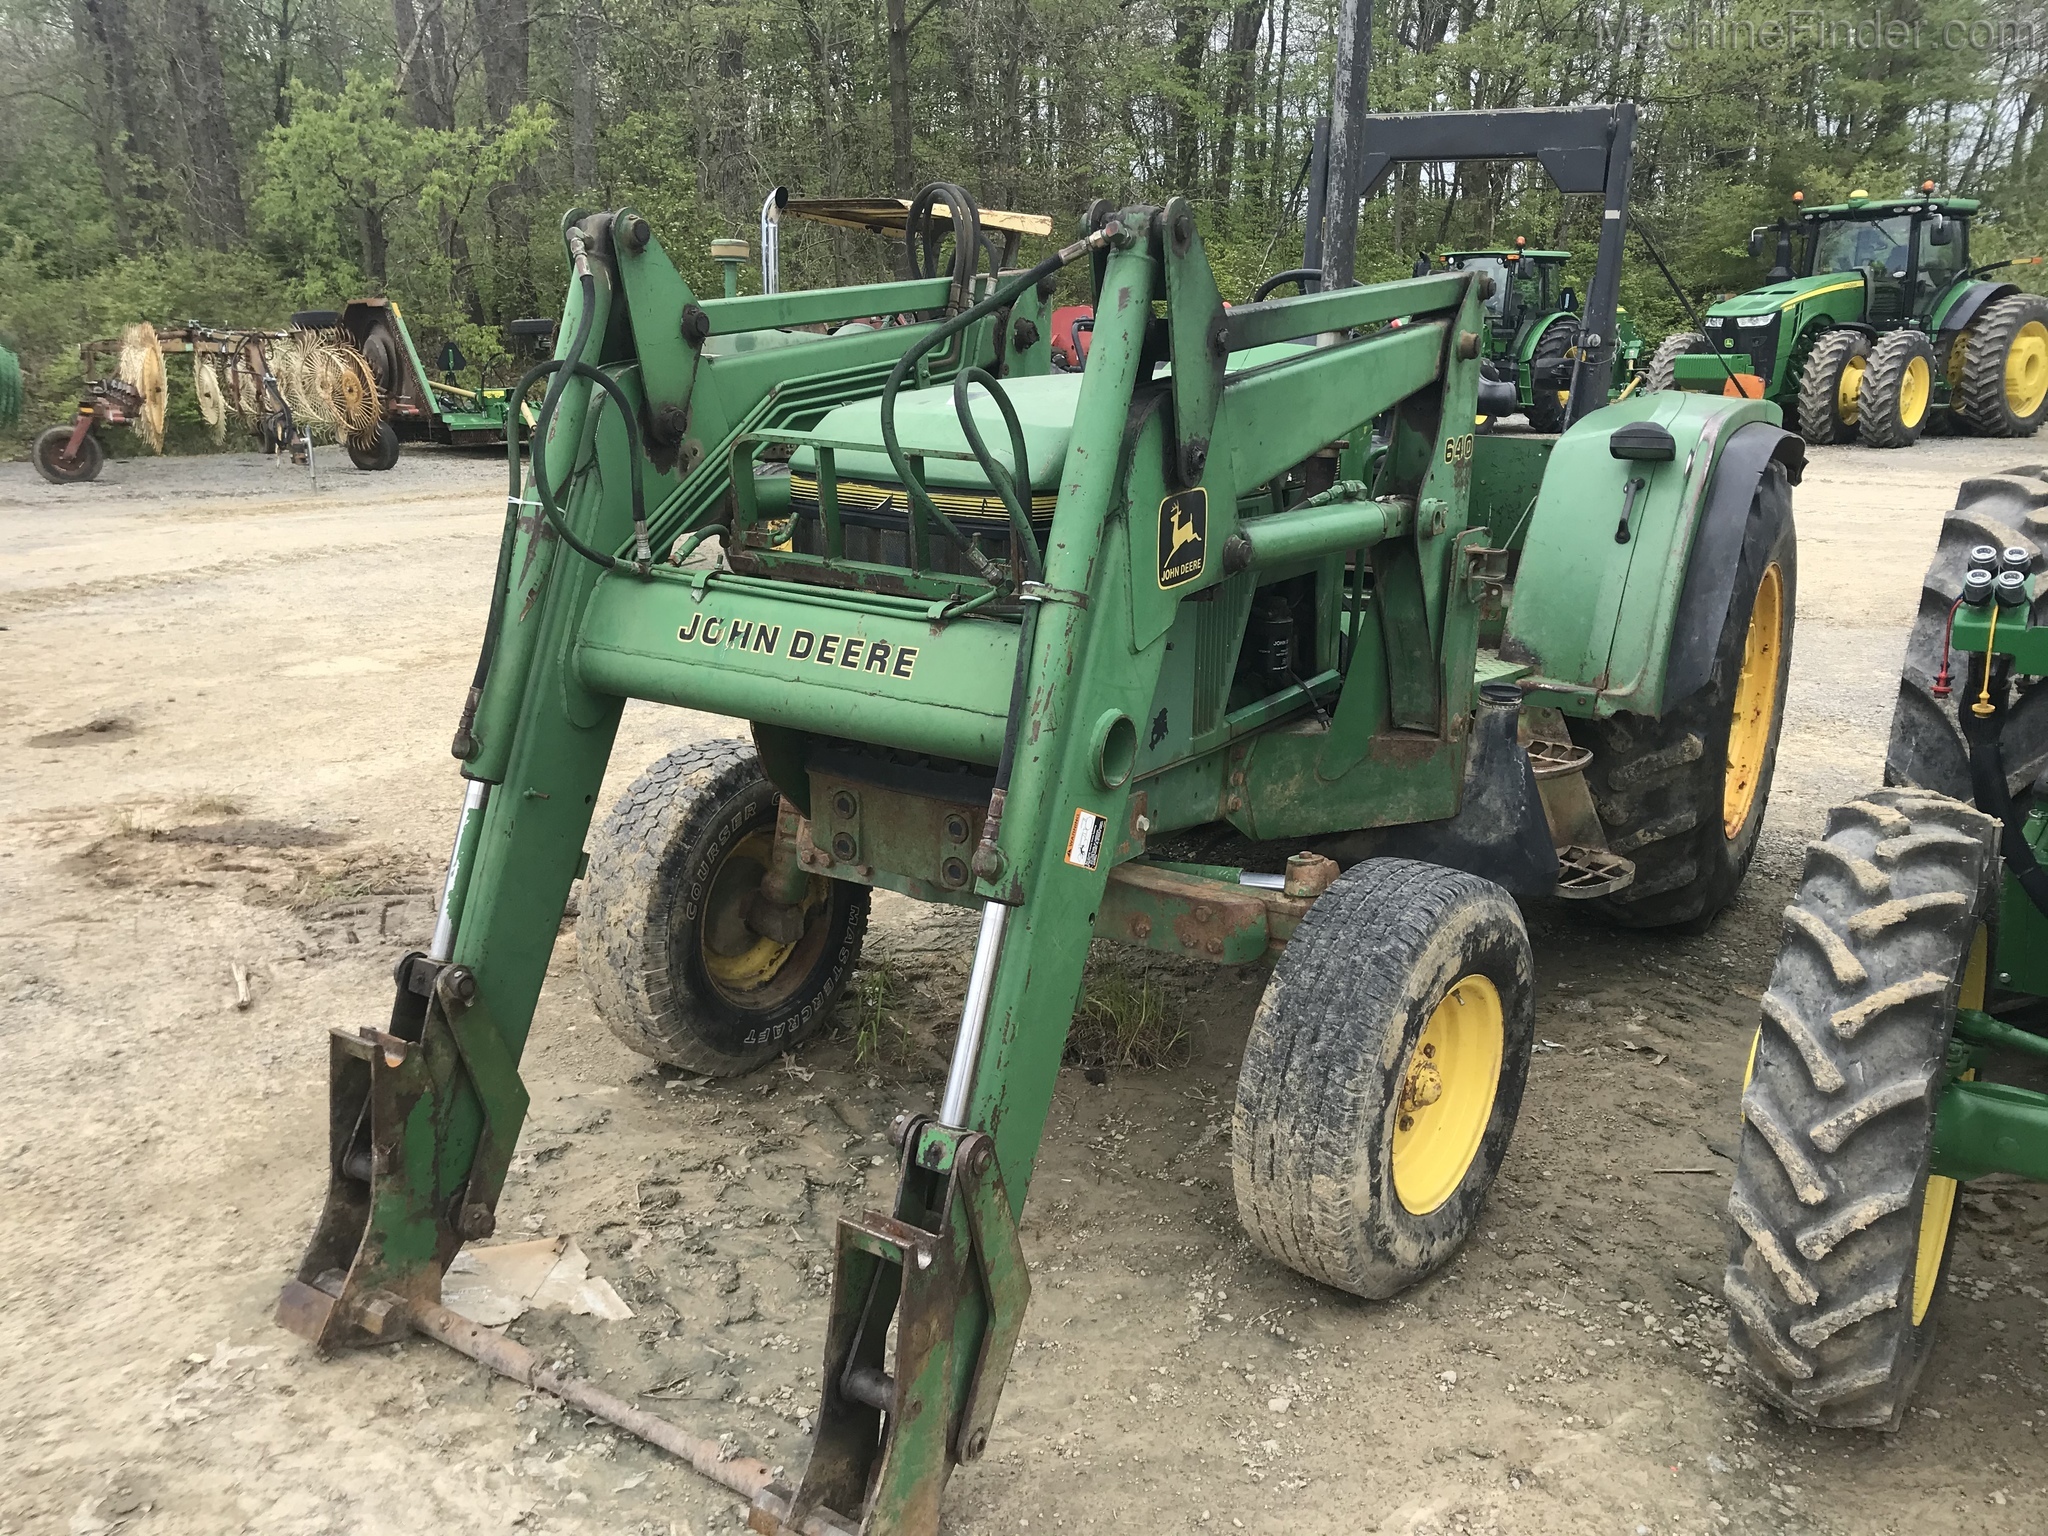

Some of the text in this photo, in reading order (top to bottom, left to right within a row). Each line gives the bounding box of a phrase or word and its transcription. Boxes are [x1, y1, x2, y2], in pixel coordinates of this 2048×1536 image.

[1444, 433, 1474, 464] 640
[1161, 558, 1201, 581] JOHN DEERE
[677, 613, 919, 680] JOHN DEERE
[686, 801, 757, 920] COURSER
[744, 904, 860, 1044] MASTERCRAFT
